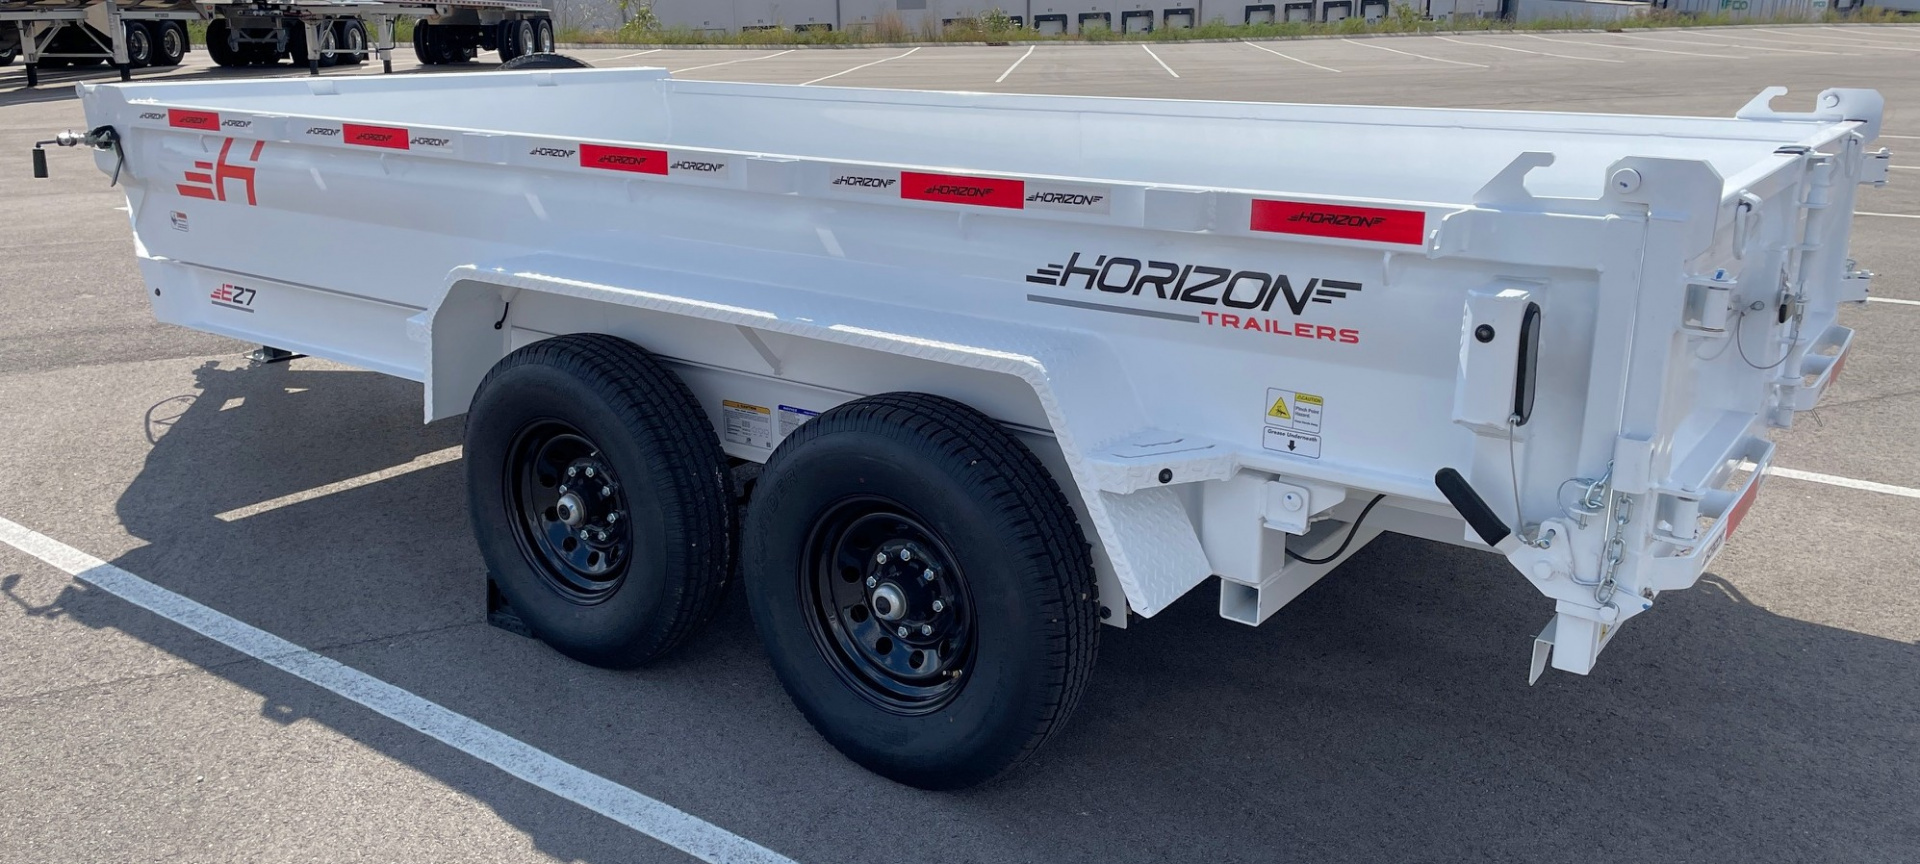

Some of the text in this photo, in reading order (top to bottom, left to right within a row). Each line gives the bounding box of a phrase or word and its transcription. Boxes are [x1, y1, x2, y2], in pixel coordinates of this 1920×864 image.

[310, 127, 337, 136] HORIZON
[360, 133, 389, 142] HORIZON
[414, 137, 445, 147] HORIZON
[535, 147, 571, 158] HORIZON
[603, 155, 642, 166] HORIZON
[676, 160, 719, 172] HORIZON
[838, 175, 890, 189] HORIZON
[931, 183, 987, 198] HORIZON
[1033, 191, 1097, 206] HORIZON
[1298, 211, 1375, 228] HORIZON
[1058, 251, 1320, 316] HORIZON
[1201, 310, 1360, 345] TRAILERS
[1287, 432, 1317, 441] Underneath
